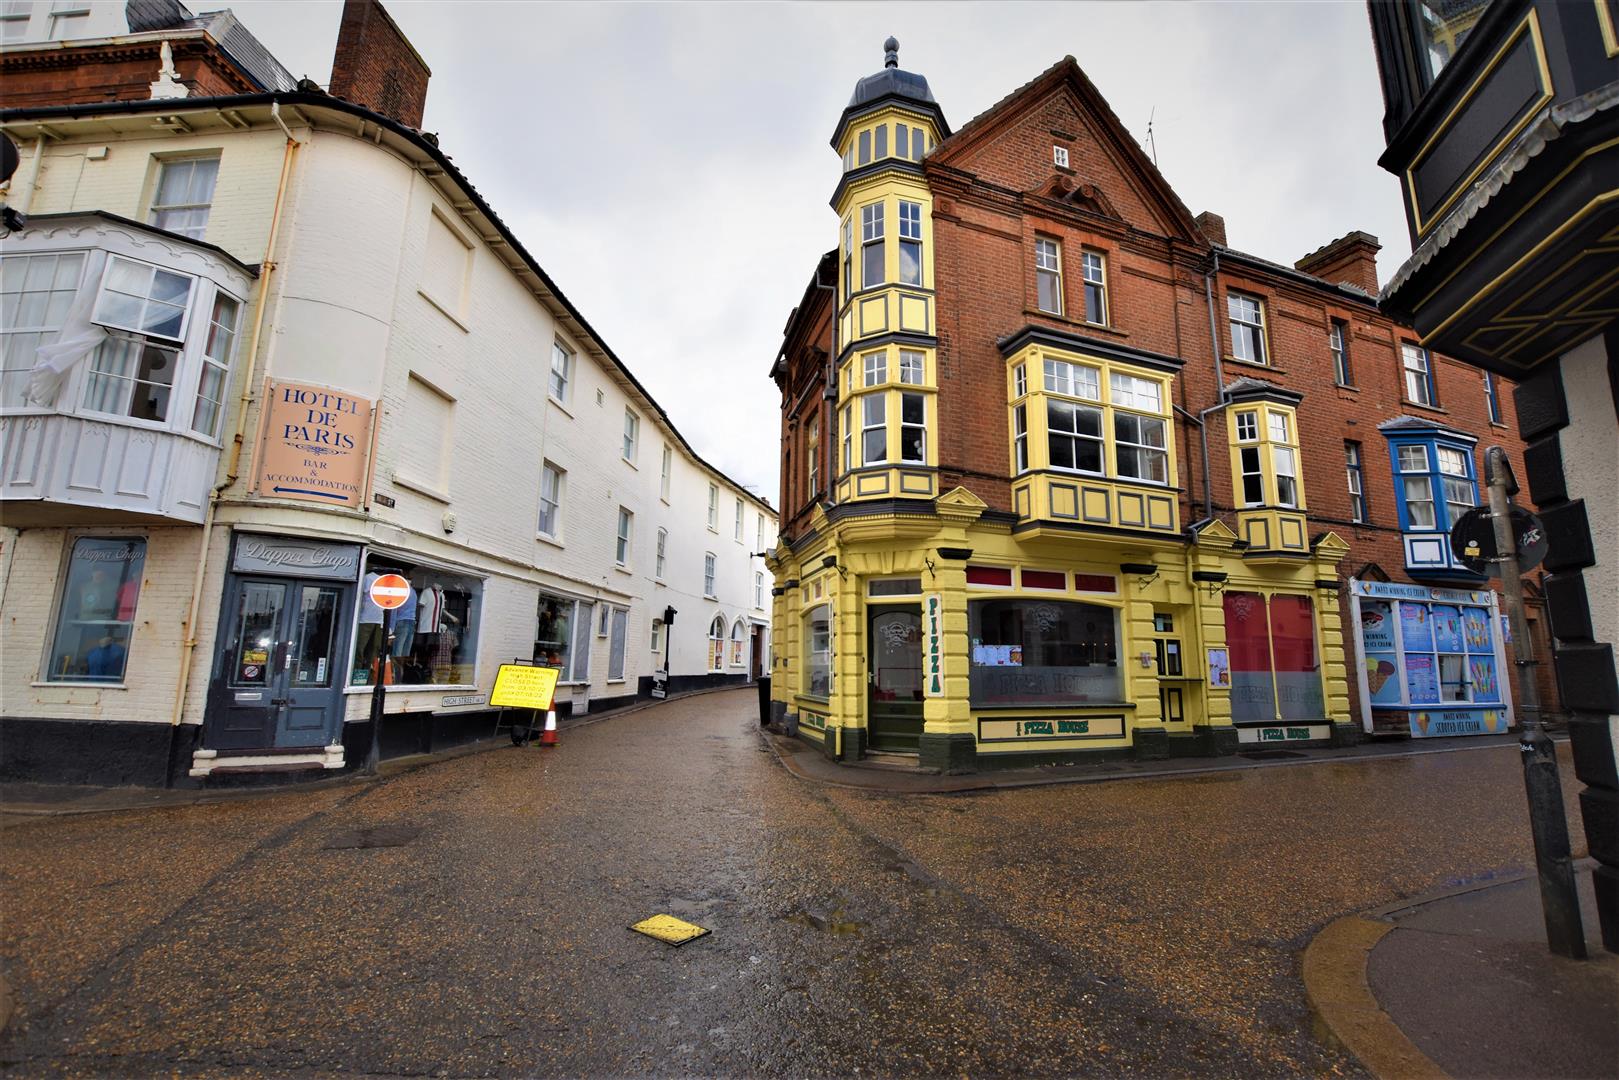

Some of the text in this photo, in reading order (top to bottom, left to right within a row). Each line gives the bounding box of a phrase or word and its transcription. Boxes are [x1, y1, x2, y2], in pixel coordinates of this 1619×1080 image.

[283, 388, 362, 416] HOTEL
[307, 409, 337, 428] DE
[283, 425, 354, 449] PARIS
[303, 459, 327, 469] BAR
[310, 469, 319, 477] &
[264, 474, 359, 493] ACCOMMODATION
[242, 542, 352, 571] Dapper Chaps
[929, 598, 941, 693] PIZZA
[1024, 721, 1054, 735] PIZZA
[1057, 720, 1089, 733] HOUSE
[1263, 728, 1285, 740] PIZZA
